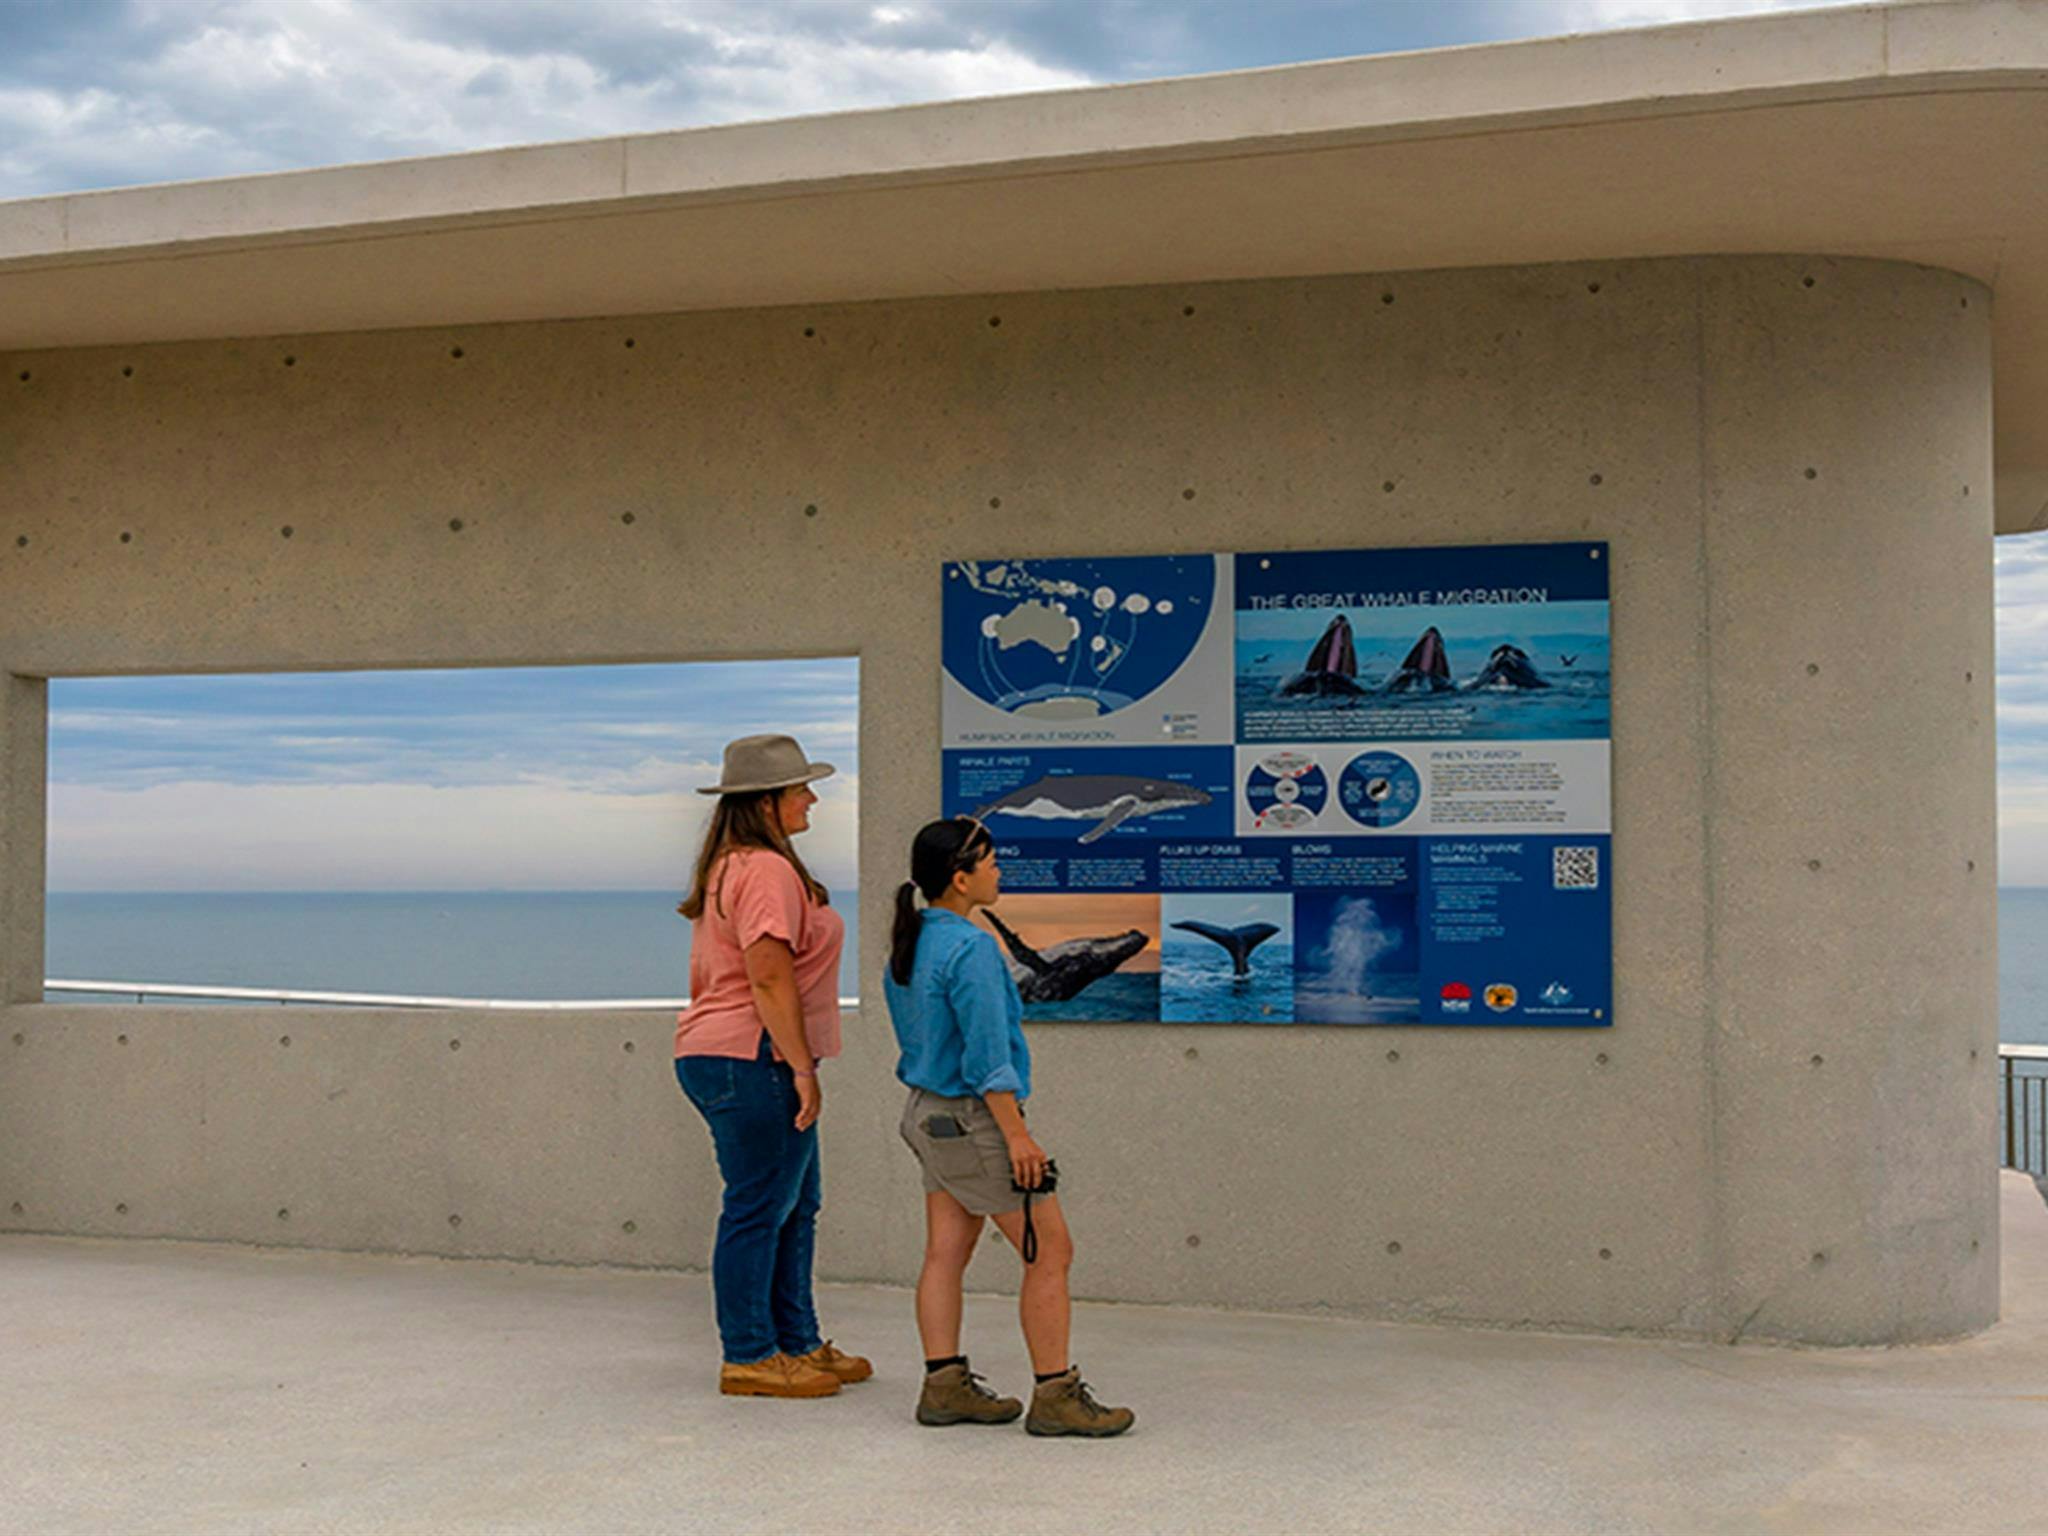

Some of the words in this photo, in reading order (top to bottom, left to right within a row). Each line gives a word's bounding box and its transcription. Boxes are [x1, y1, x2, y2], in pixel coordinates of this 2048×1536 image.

[1250, 595, 1287, 610] THE
[1291, 593, 1356, 609] GREAT
[1360, 591, 1431, 608] WHALE
[1436, 587, 1548, 606] MIGRATION
[959, 731, 1017, 742] HUMPBACK
[1020, 731, 1055, 741] WHALE
[1058, 730, 1115, 741] MIGRATION
[1430, 750, 1464, 760] WHEN
[1466, 750, 1481, 760] TO
[1483, 750, 1522, 760] WATCH
[959, 757, 995, 766] WHALE
[997, 756, 1031, 766] PARTS
[1159, 845, 1192, 856] FLUKE
[1194, 845, 1210, 855] UP
[1291, 844, 1332, 855] BLOWS
[1430, 843, 1478, 855] HELPING
[1480, 843, 1523, 854] MARINE
